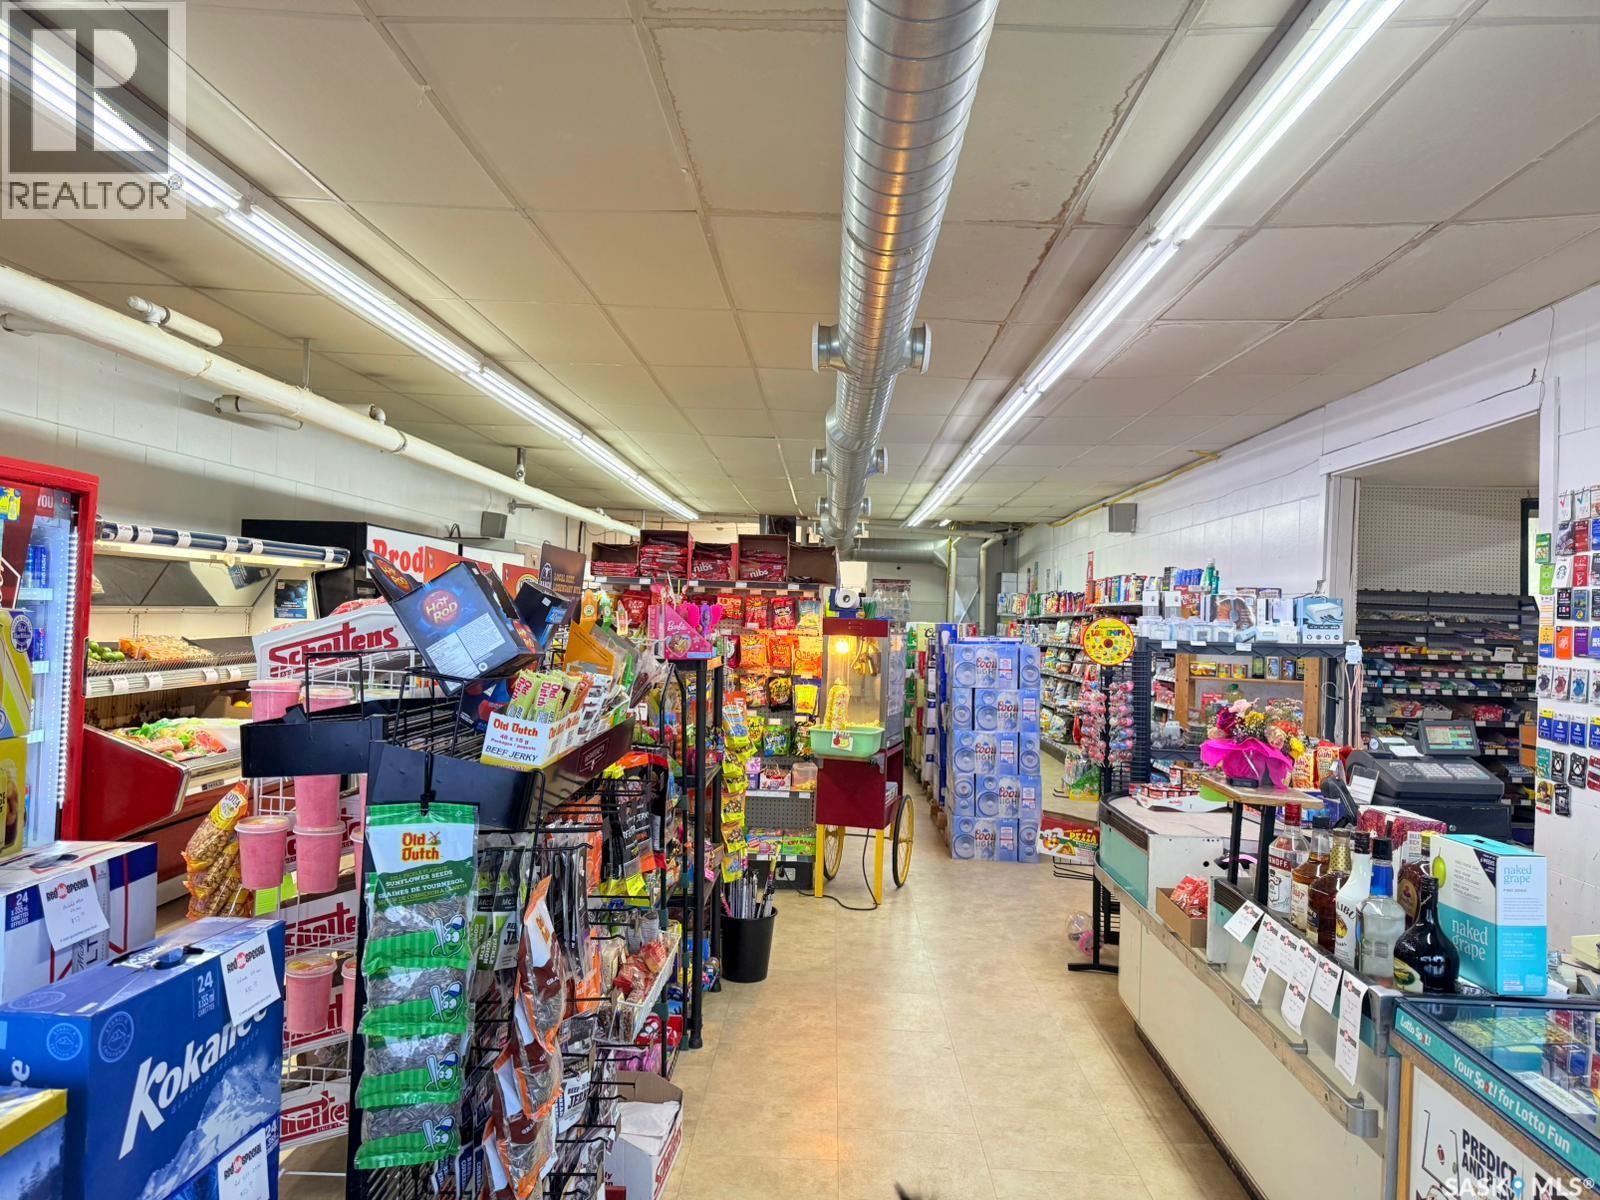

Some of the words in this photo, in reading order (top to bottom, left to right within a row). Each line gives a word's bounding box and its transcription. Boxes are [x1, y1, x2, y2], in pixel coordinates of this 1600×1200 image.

[373, 539, 424, 573] Prod
[693, 562, 713, 573] nibs
[750, 569, 769, 578] nibs
[426, 596, 448, 614] HOT
[433, 602, 458, 623] ROD
[493, 719, 509, 731] Old
[512, 720, 538, 737] Dutch
[485, 745, 509, 757] BEEF
[509, 749, 538, 763] JERKY
[402, 832, 426, 846] Old
[1070, 832, 1096, 844] PIZZA
[402, 847, 439, 861] Dutch
[385, 874, 430, 887] SUNFLOWER
[431, 870, 453, 879] SEEDS
[1503, 864, 1532, 875] naked
[422, 878, 464, 891] TOURNESOL
[1503, 875, 1531, 884] grape
[16, 892, 29, 906] 24
[1452, 920, 1488, 946] naked
[1452, 936, 1486, 961] grape
[198, 970, 214, 994] 24
[1400, 1016, 1415, 1035] Lotto
[1415, 1026, 1431, 1047] Spot!
[1453, 1055, 1474, 1080] Your
[1474, 1070, 1497, 1098] Spot!
[1499, 1089, 1515, 1109] for
[1515, 1102, 1546, 1134] Lotto
[1547, 1125, 1571, 1155] Fun
[1462, 1129, 1518, 1180] PREDICT
[1461, 1152, 1484, 1180] AND
